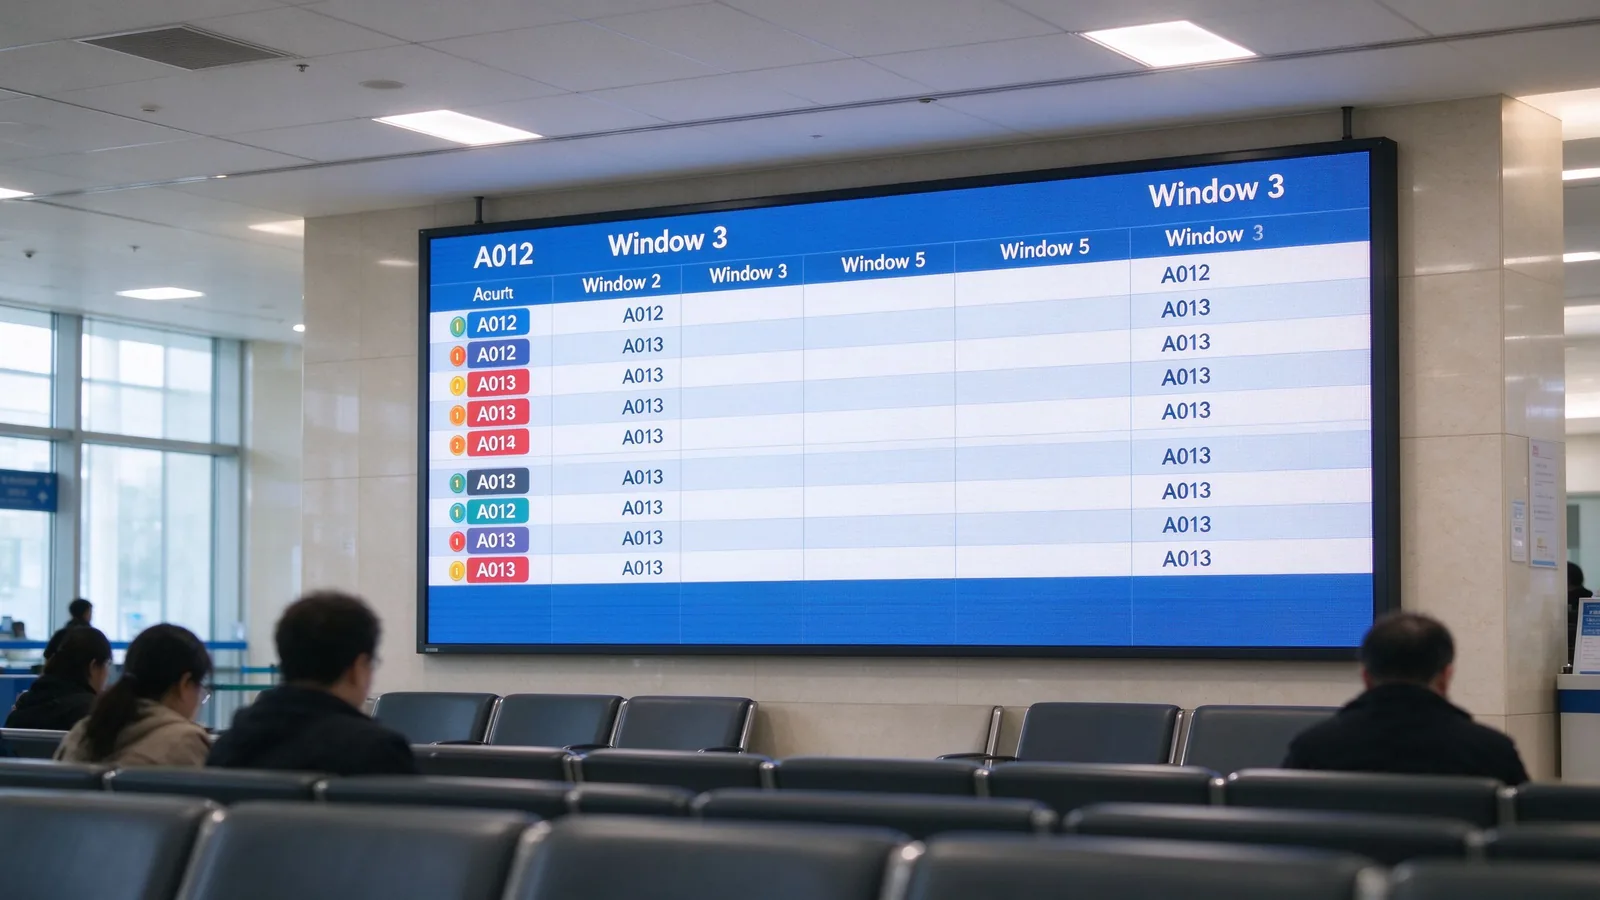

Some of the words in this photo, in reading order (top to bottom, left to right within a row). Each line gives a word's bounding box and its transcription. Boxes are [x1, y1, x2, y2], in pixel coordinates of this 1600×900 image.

[1149, 178, 1258, 207] Window
[1268, 174, 1284, 198] 3
[608, 229, 704, 256] Window
[713, 226, 727, 248] 3
[1165, 226, 1243, 246] Window
[1254, 225, 1263, 240] 3
[474, 242, 533, 268] A012
[1000, 240, 1073, 260] Window
[1079, 238, 1089, 254] 5
[842, 254, 909, 273] Window
[915, 252, 926, 267] 5
[710, 265, 773, 283] Window
[778, 264, 787, 278] 3
[1160, 264, 1210, 284] A012
[583, 275, 646, 293] Window
[652, 274, 660, 288] 2
[622, 306, 664, 324] A012
[1160, 299, 1211, 319] A013
[477, 315, 517, 333] A012
[621, 337, 664, 354] A013
[1161, 333, 1211, 353] A013
[477, 345, 517, 363] A012
[477, 375, 516, 392] A013
[622, 367, 664, 385] A013
[1160, 367, 1211, 387] A013
[477, 405, 516, 422] A013
[621, 398, 664, 416] A013
[1161, 402, 1211, 421] A013
[622, 429, 664, 446] A013
[1161, 447, 1211, 466] A013
[477, 474, 516, 490] A013
[621, 469, 664, 486] A013
[1161, 482, 1212, 500] A013
[476, 504, 516, 519] A012
[621, 500, 663, 516] A013
[1161, 516, 1212, 534] A013
[476, 533, 516, 548] A013
[621, 530, 664, 546] A013
[621, 560, 663, 576] A013
[1162, 550, 1212, 568] A013
[476, 562, 516, 577] A013
